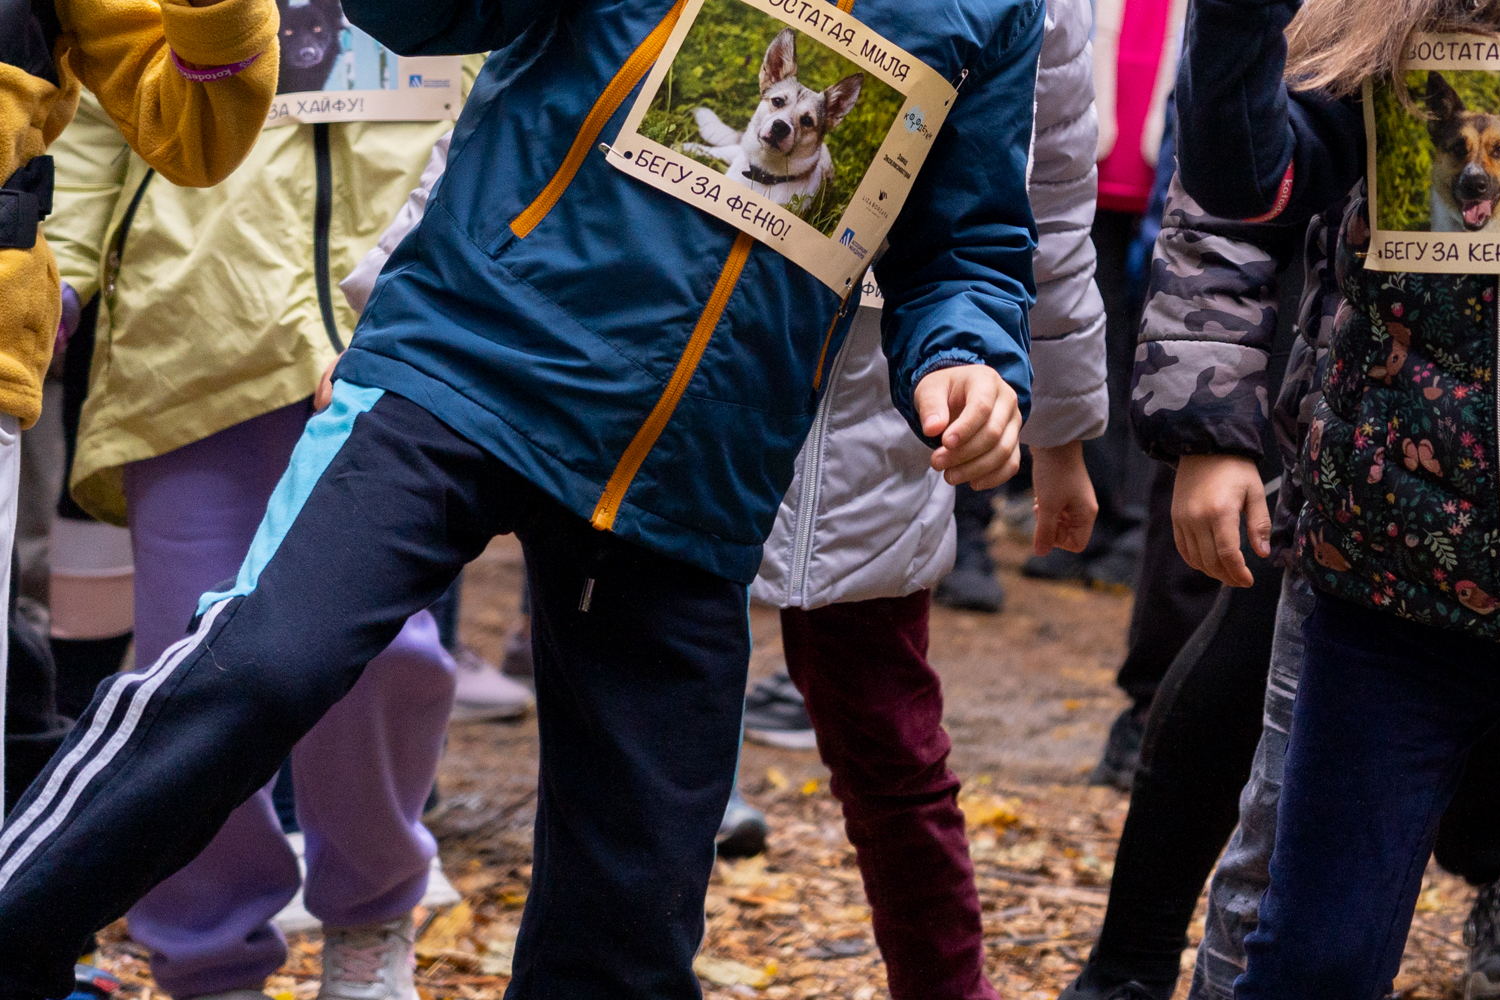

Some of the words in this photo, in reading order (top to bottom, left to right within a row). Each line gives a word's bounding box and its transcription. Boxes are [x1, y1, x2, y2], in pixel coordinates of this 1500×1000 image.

[297, 98, 364, 115] ХАЙФУ!
[634, 149, 694, 184] БЕГУ
[691, 173, 721, 203] ЗА
[726, 194, 792, 242] ФЕНЮ!
[1384, 242, 1428, 261] БЕГУ
[1432, 242, 1459, 261] ЗА
